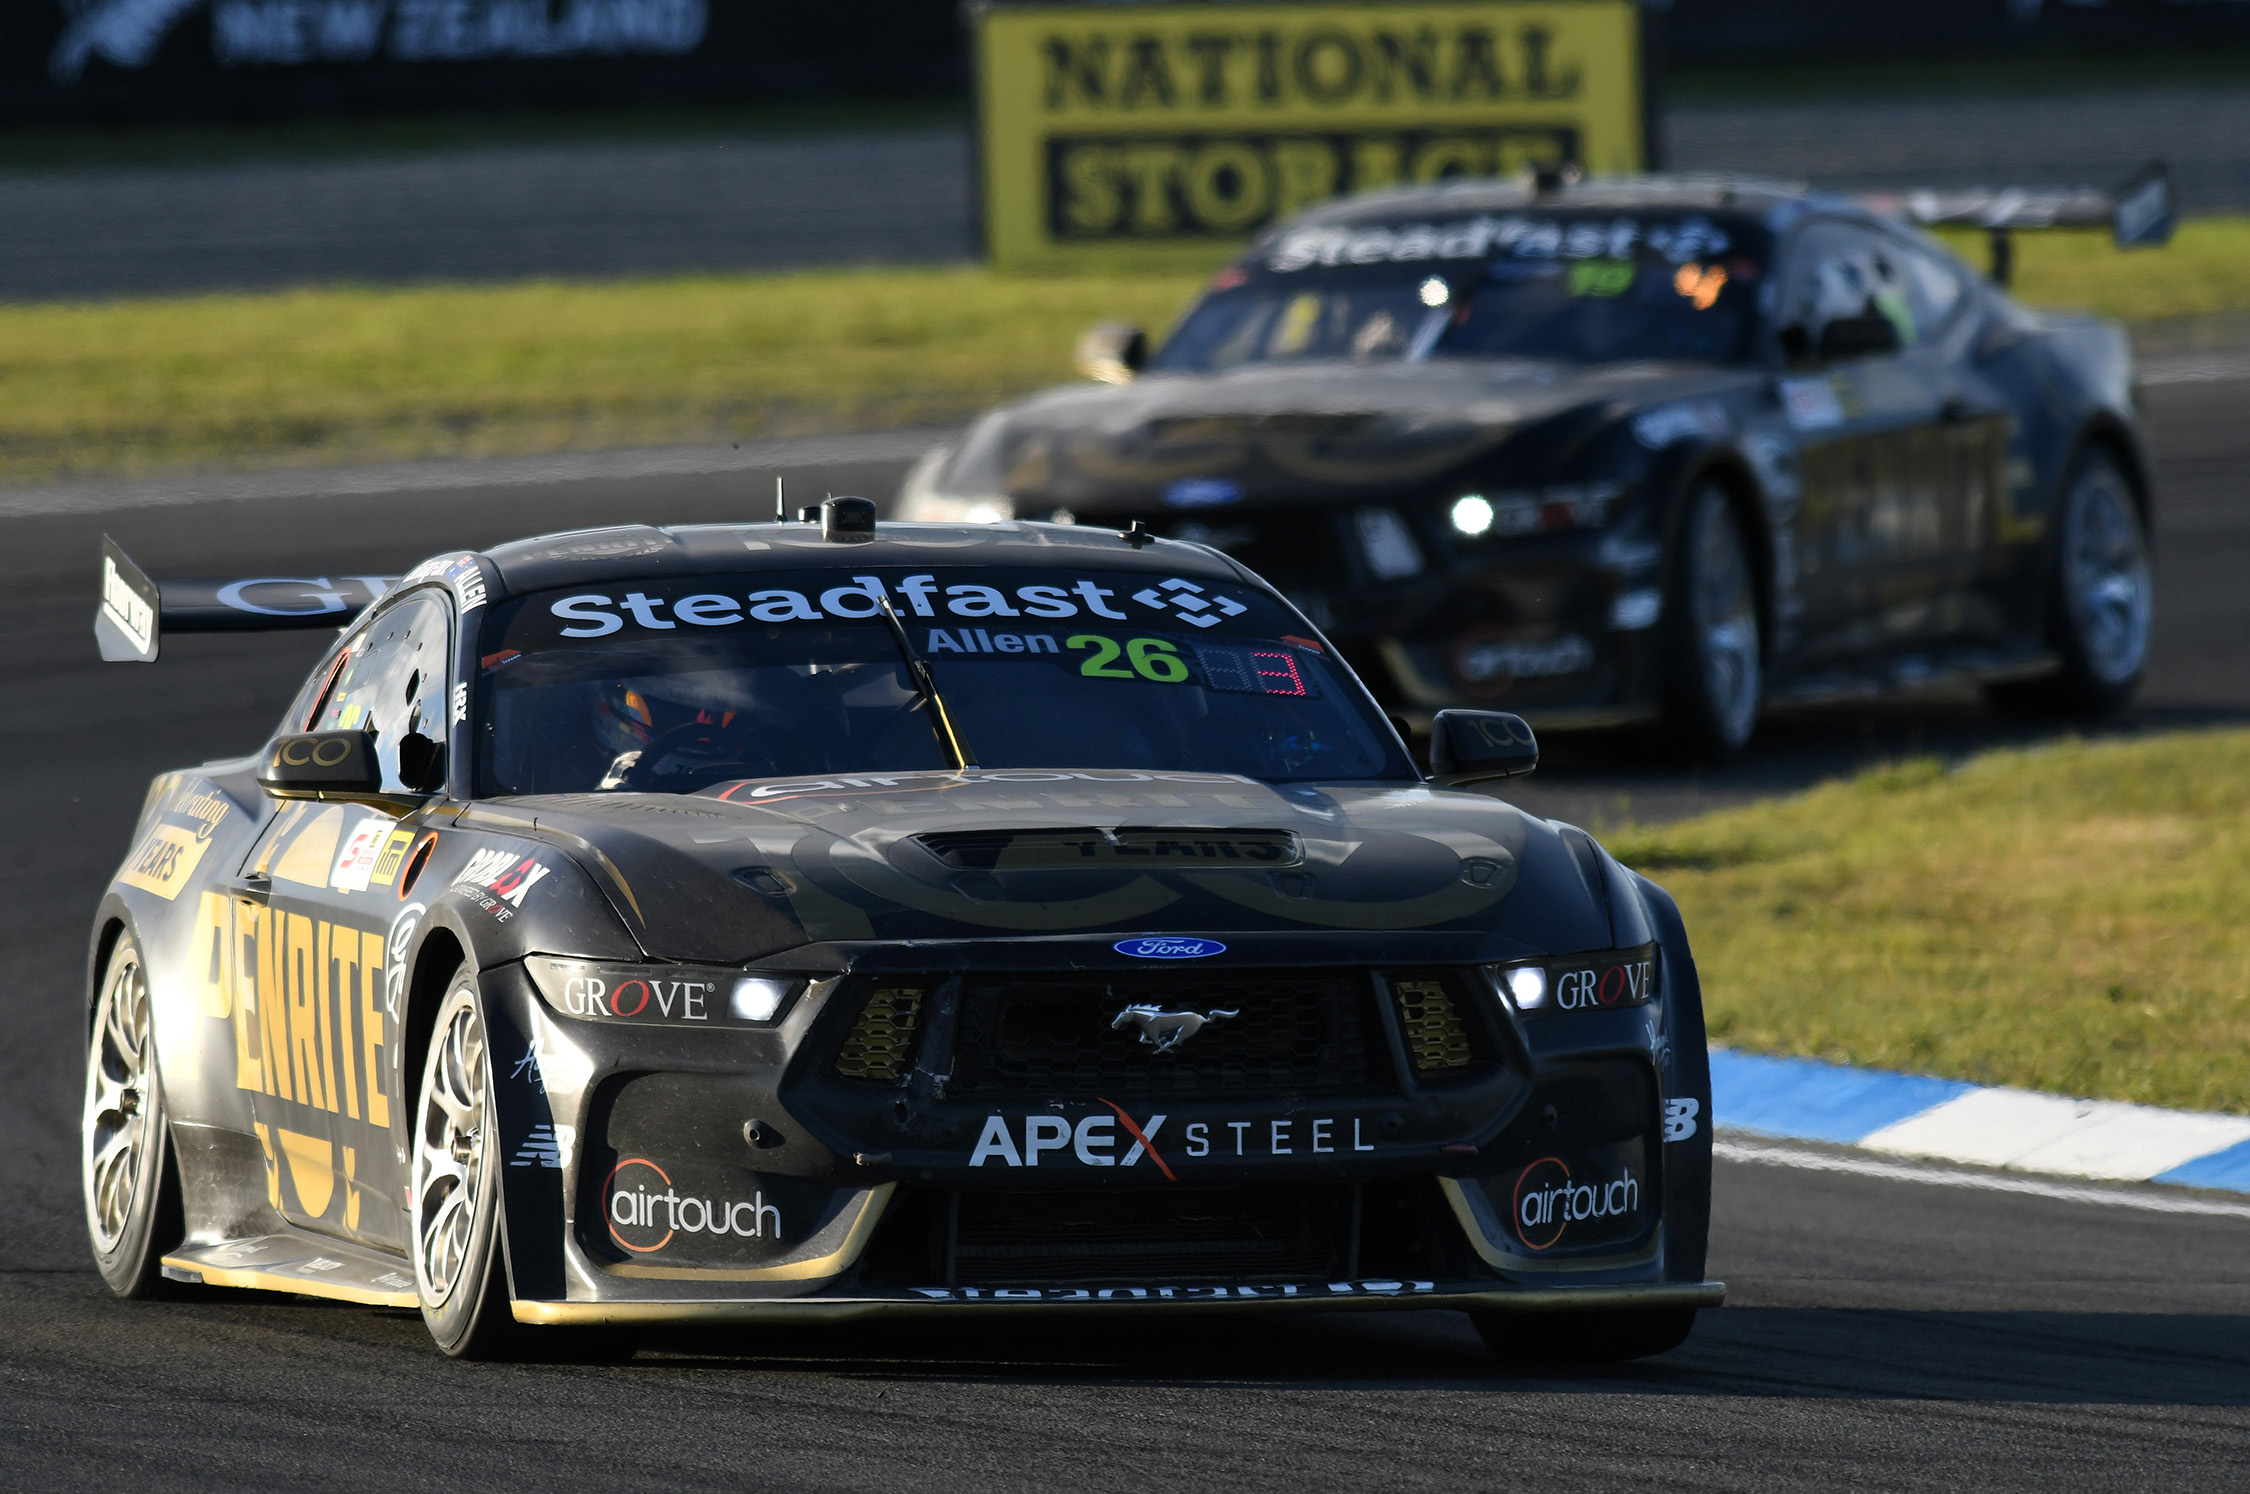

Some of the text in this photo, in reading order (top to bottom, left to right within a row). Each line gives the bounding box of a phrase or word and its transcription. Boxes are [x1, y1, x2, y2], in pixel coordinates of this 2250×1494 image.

[1041, 26, 1582, 113] NATIONAL
[454, 565, 488, 615] ALLEN
[550, 574, 1128, 639] Steadfast
[927, 628, 1189, 684] Allen 26
[453, 681, 468, 729] HRX
[133, 838, 184, 883] YEARS
[161, 890, 391, 1129] PENRITE
[1556, 961, 1650, 1010] GROVE
[968, 1097, 1375, 1182] APEX STEEL
[611, 1184, 782, 1240] airtouch
[1519, 1167, 1639, 1228] airtouch
